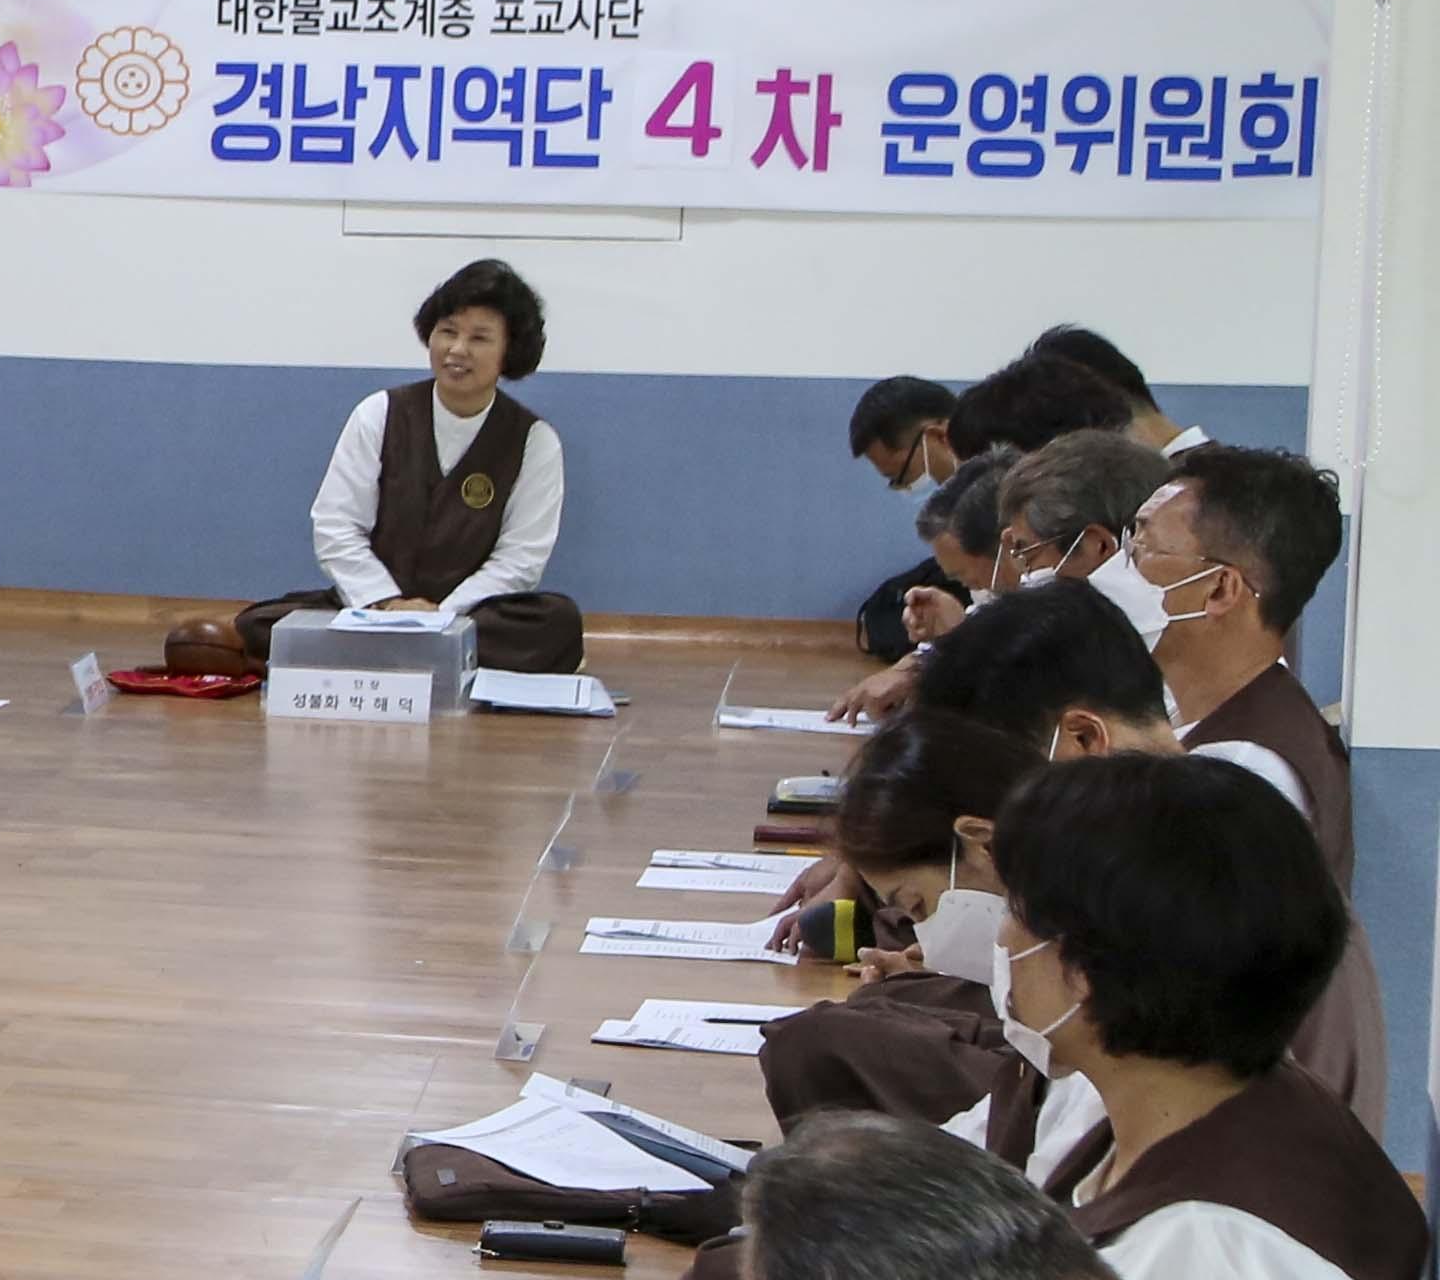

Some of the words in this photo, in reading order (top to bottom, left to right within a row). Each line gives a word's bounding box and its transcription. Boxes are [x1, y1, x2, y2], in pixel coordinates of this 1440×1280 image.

[210, 61, 614, 168] 경남지역단
[644, 60, 723, 158] 4
[750, 68, 843, 172] 차
[879, 71, 1320, 180] 운영위원회
